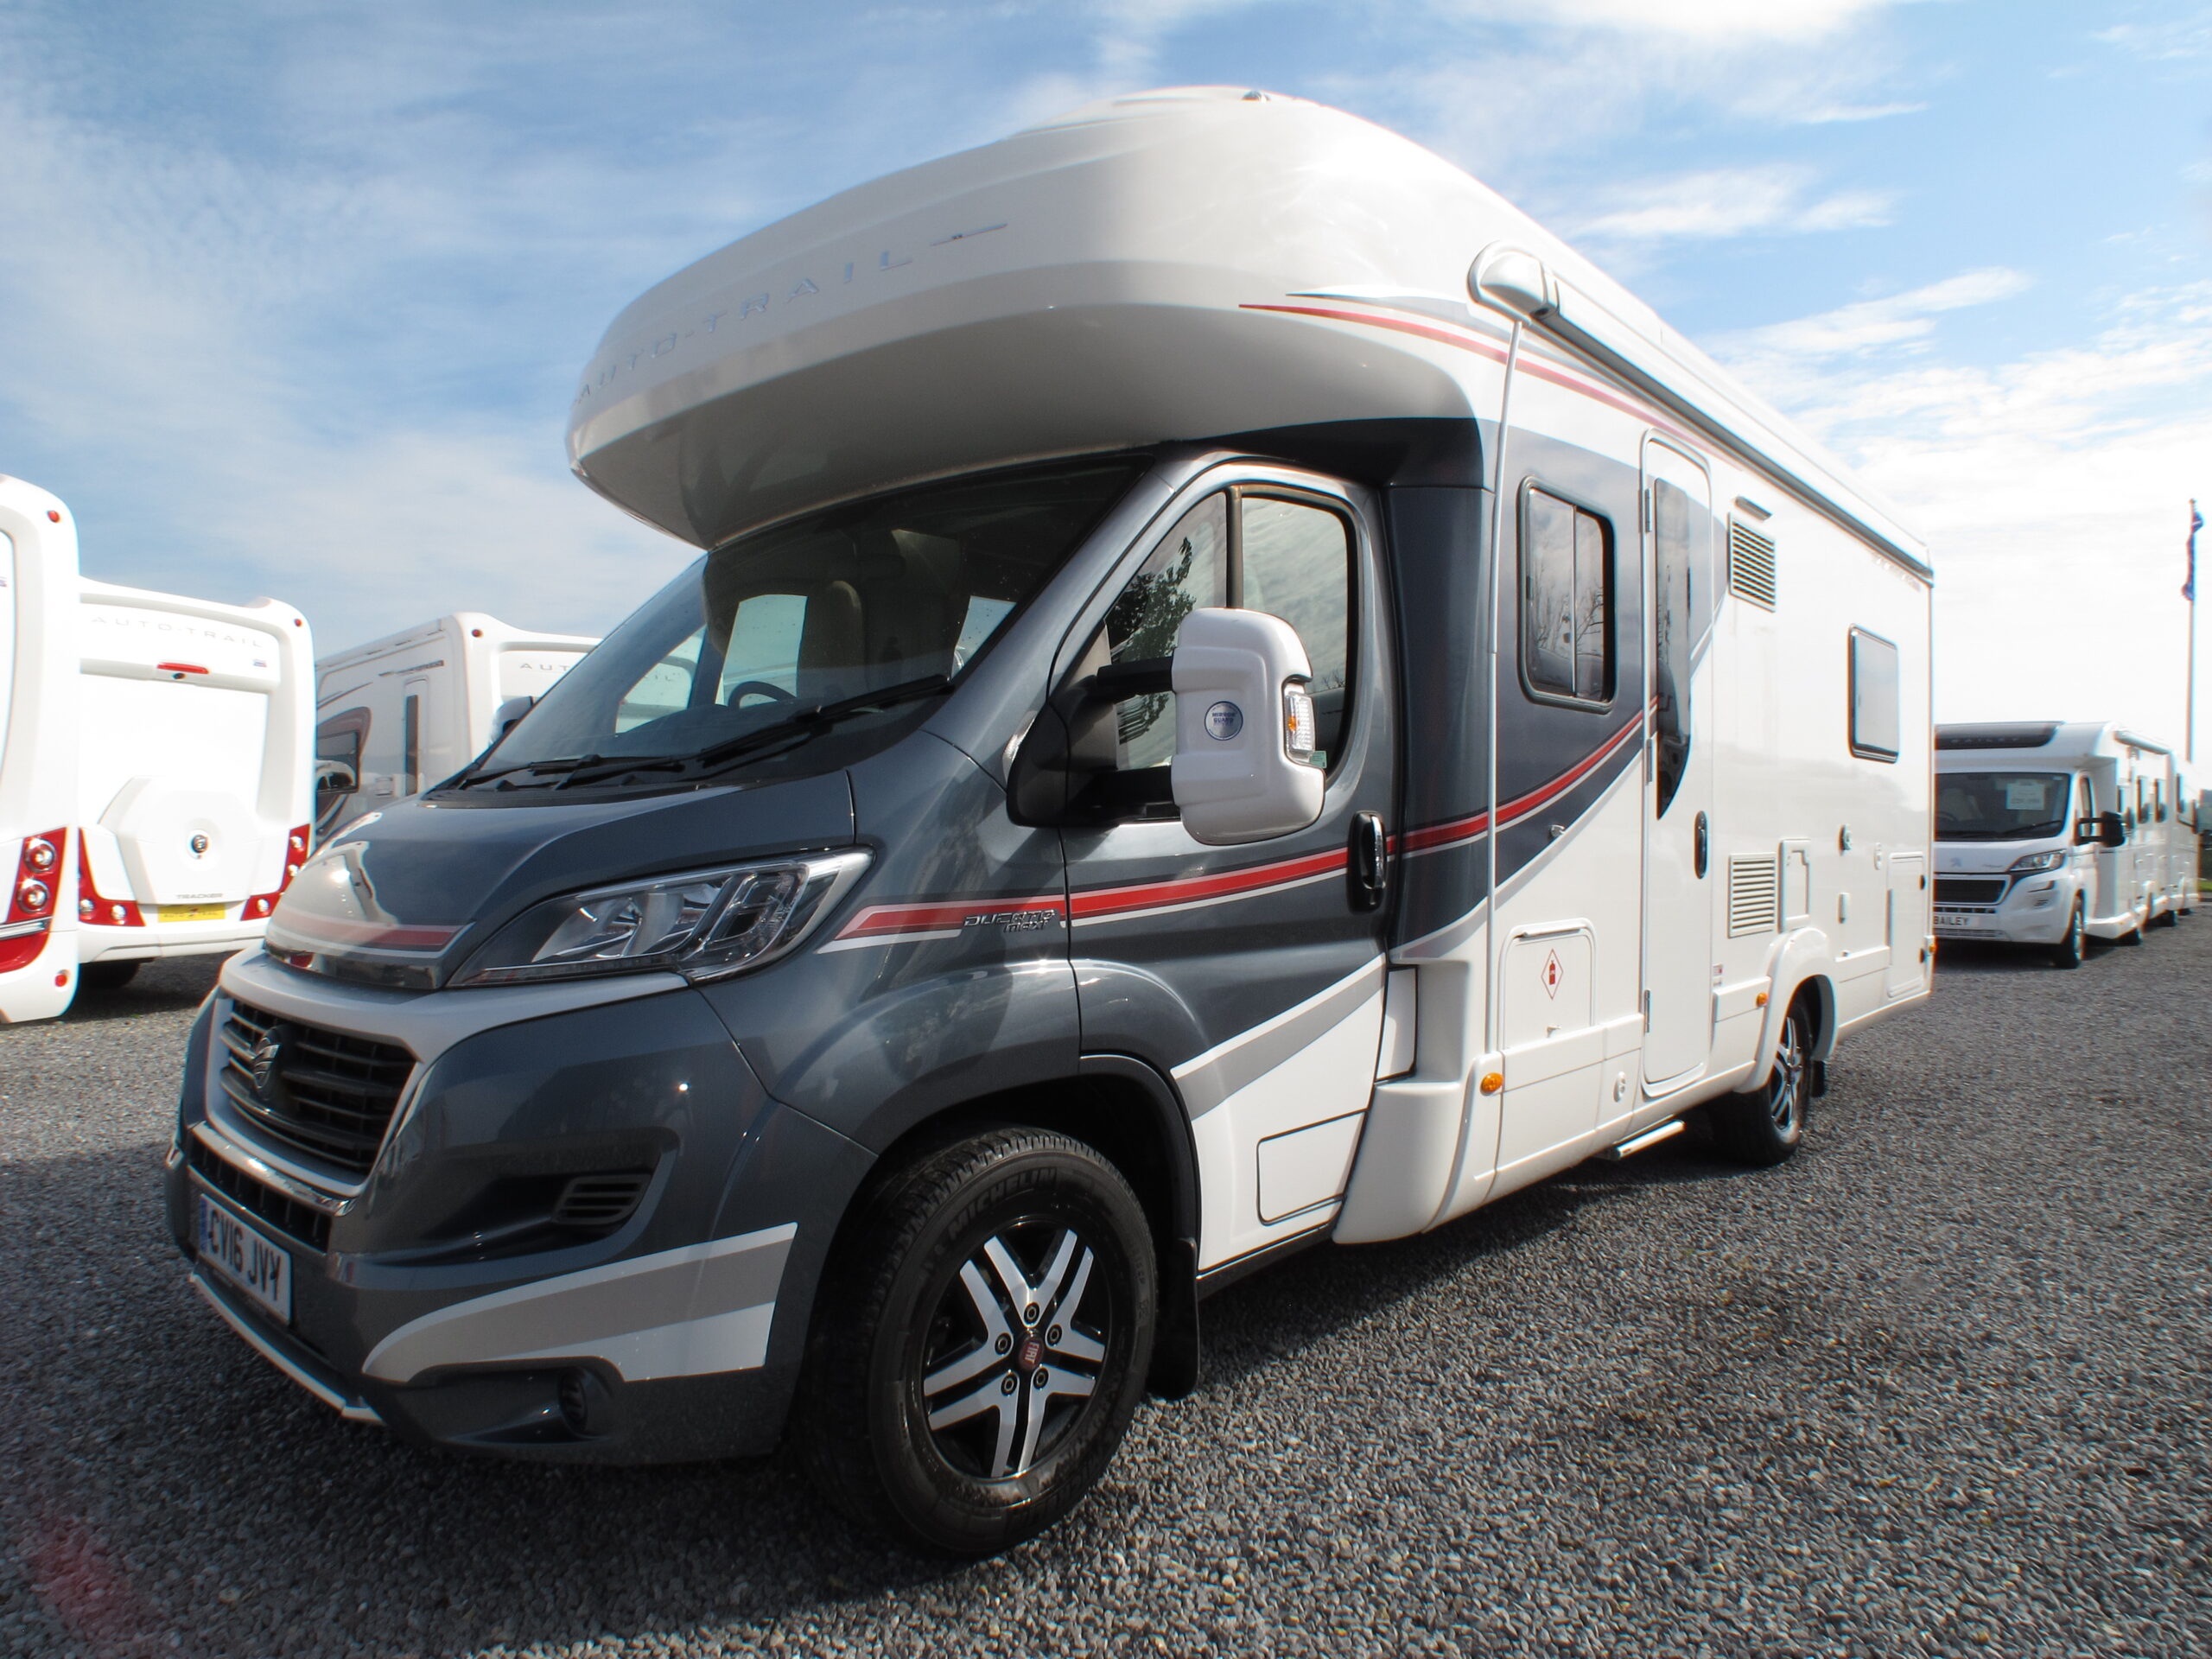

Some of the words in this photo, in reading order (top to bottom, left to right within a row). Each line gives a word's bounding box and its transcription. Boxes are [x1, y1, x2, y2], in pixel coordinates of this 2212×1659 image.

[581, 250, 912, 398] AUTO-TRAIL
[91, 616, 264, 648] AUTO-TRAIL
[963, 908, 1055, 927] DUCATO
[1934, 916, 1969, 926] BAILEY
[947, 1166, 1058, 1239] MICHELIN
[247, 1238, 282, 1301] JVY
[1024, 1341, 1040, 1364] FIAT
